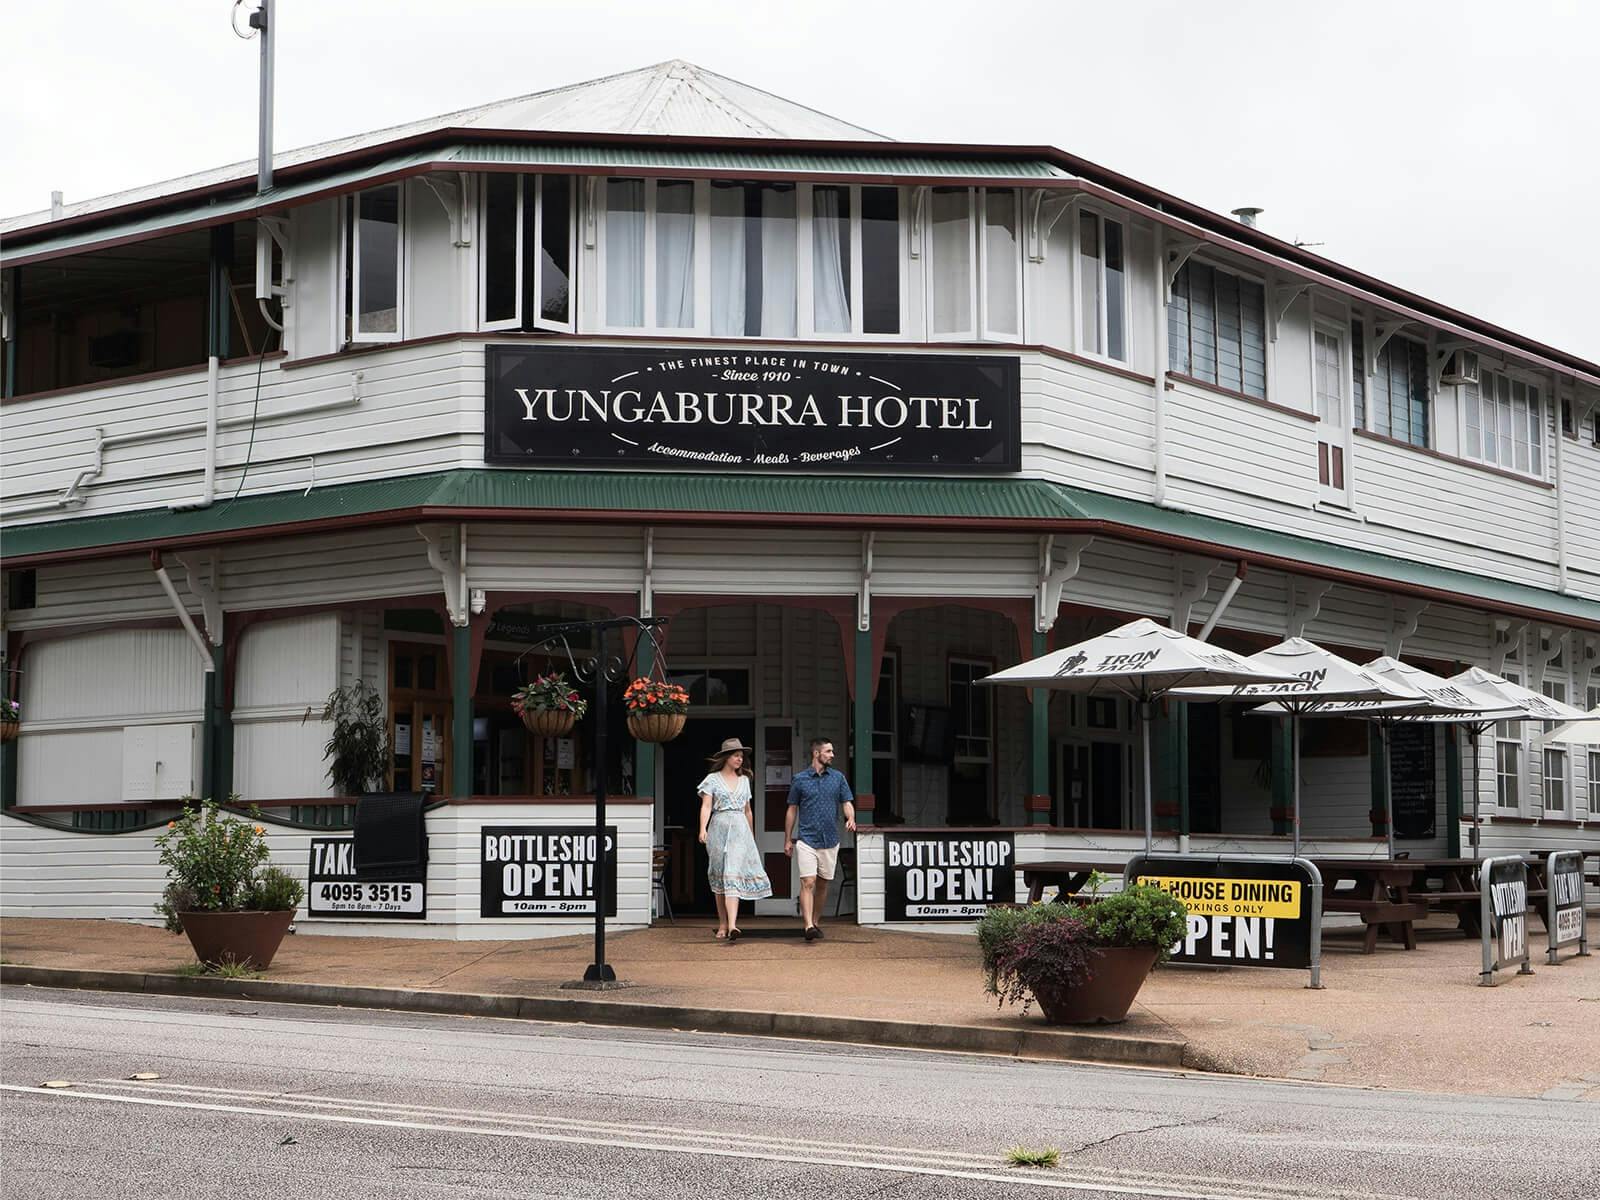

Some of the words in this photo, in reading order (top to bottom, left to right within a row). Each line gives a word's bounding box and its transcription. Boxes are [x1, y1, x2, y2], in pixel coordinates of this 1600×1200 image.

[659, 360, 685, 371] THE
[691, 356, 738, 368] FINEST
[745, 356, 786, 367] PLACE
[793, 359, 807, 369] IN
[813, 361, 850, 376] TOWN
[721, 369, 759, 382] Since
[762, 371, 791, 382] 1910
[515, 388, 827, 428] YUNGABURRA
[837, 394, 993, 430] HOTEL
[647, 442, 743, 463] Accommodation
[753, 453, 790, 464] Meals
[800, 445, 861, 462] Beverages
[1101, 648, 1162, 665] IRON
[1292, 668, 1327, 681] ON
[1262, 681, 1322, 693] JACK
[888, 841, 1011, 867] BOTTLESHOP
[503, 863, 594, 897] OPEN!
[906, 868, 993, 901] OPEN!
[321, 884, 363, 901] 4095
[368, 884, 412, 902] 3515
[1231, 882, 1293, 903] DINING
[384, 903, 401, 912] Days
[513, 902, 547, 910] 10am
[559, 902, 587, 911] 8pm
[917, 906, 949, 914] 10am
[1185, 903, 1229, 913] OKINGS
[1234, 904, 1265, 914] ONLY
[1170, 914, 1275, 960] PEN!
